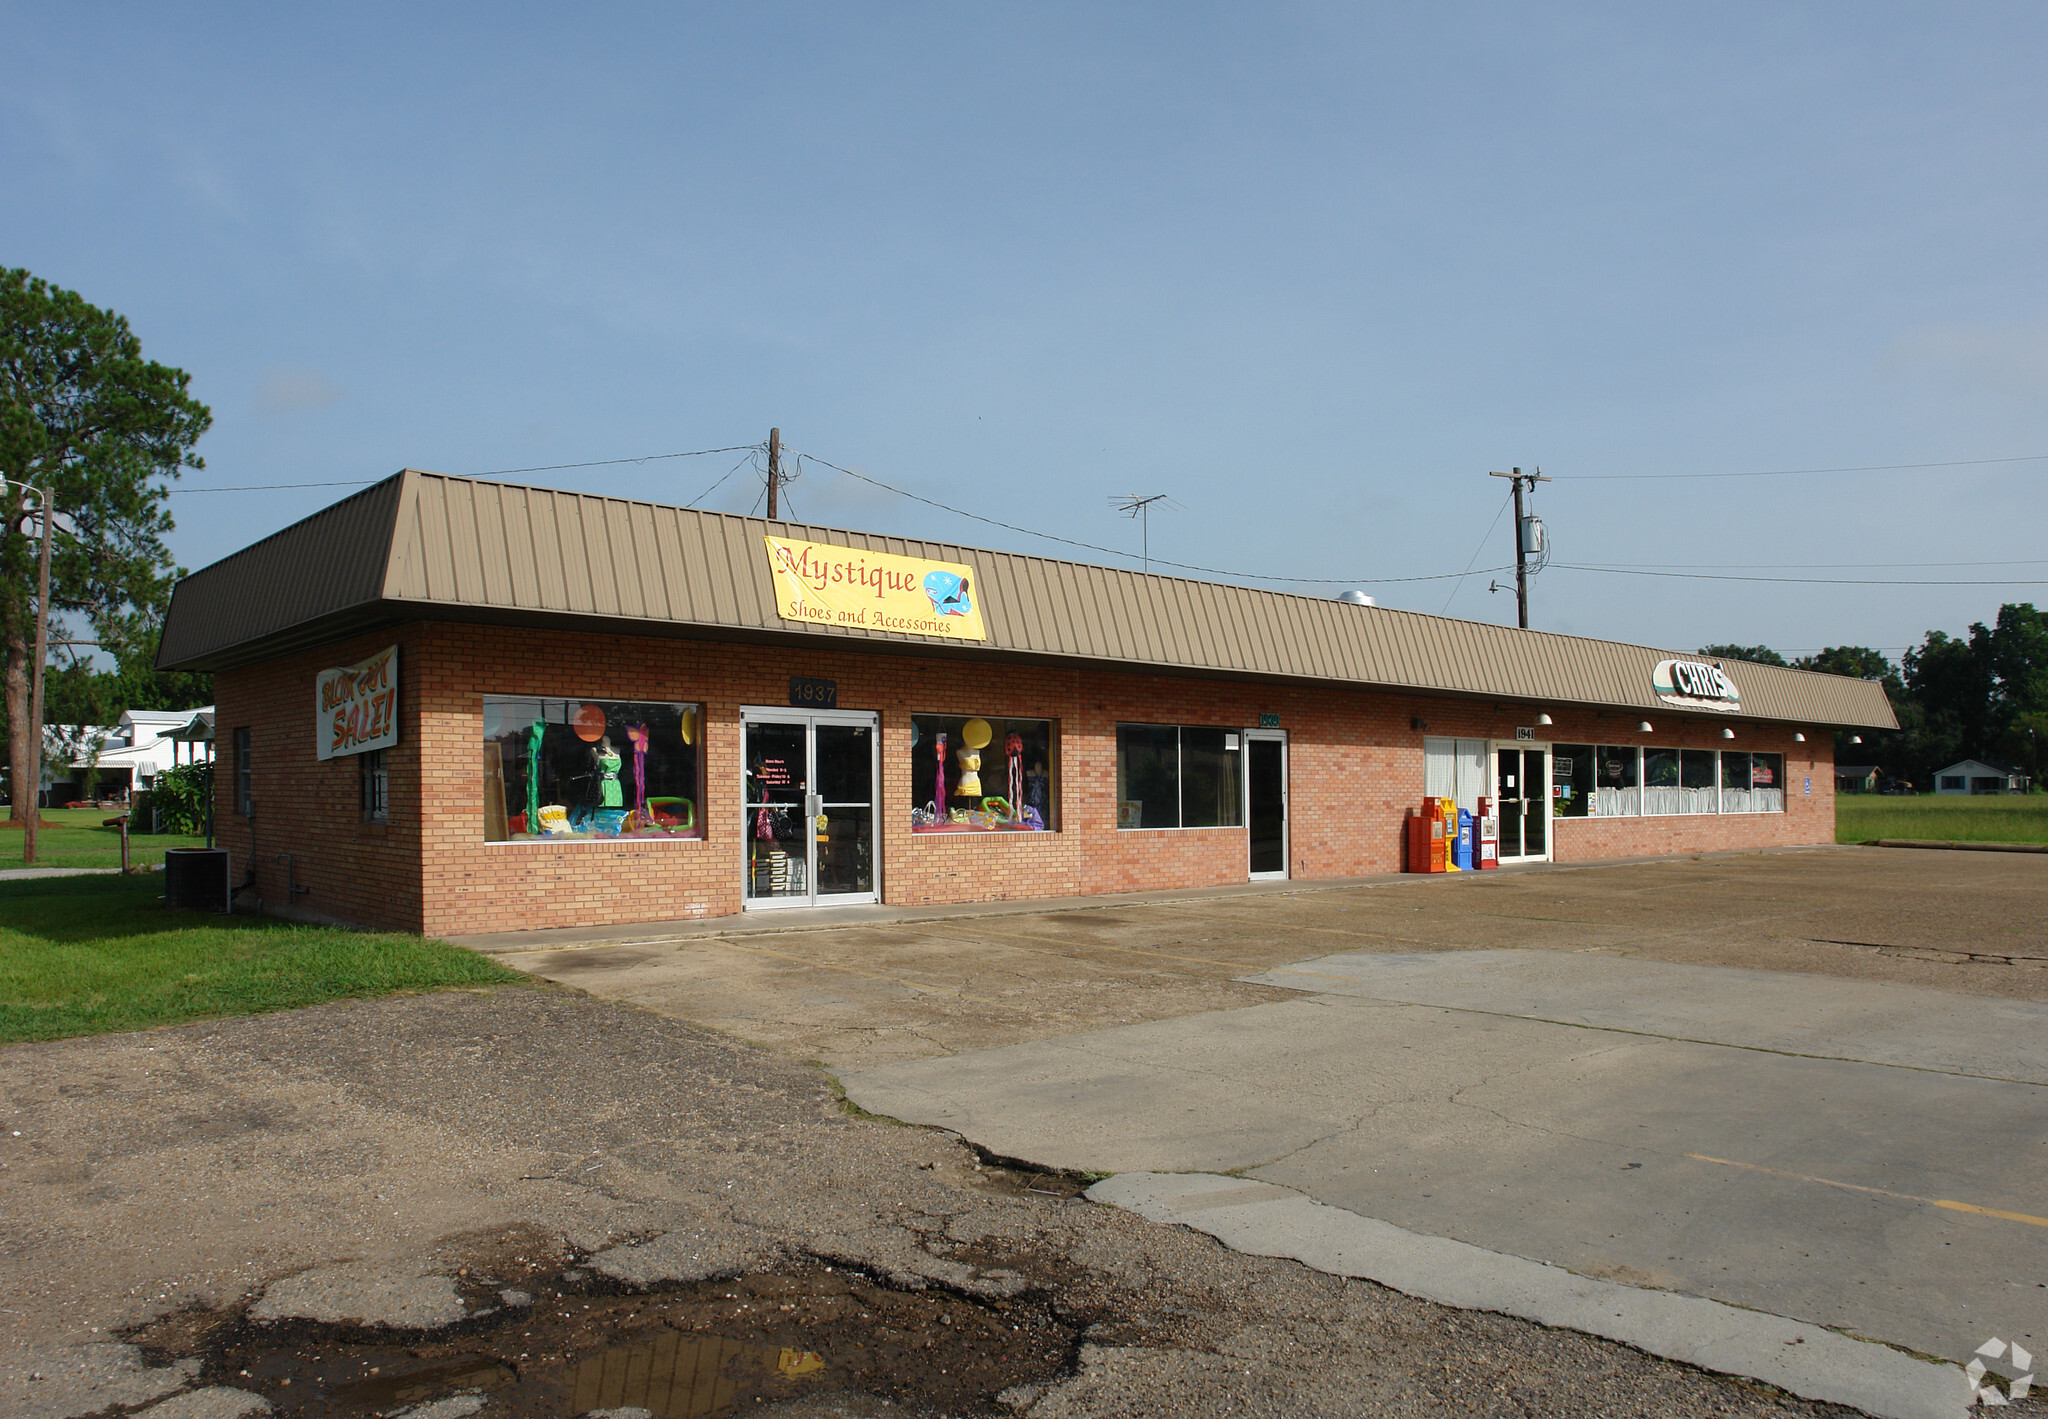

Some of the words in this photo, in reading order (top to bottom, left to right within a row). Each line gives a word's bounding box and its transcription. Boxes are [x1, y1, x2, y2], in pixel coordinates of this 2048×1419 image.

[776, 545, 916, 598] Mystique
[788, 600, 832, 620] Shoes
[838, 608, 866, 624] and
[872, 611, 951, 633] Accessories
[795, 684, 835, 702] 1937
[332, 687, 395, 752] SALE!
[1517, 728, 1534, 739] 1941
